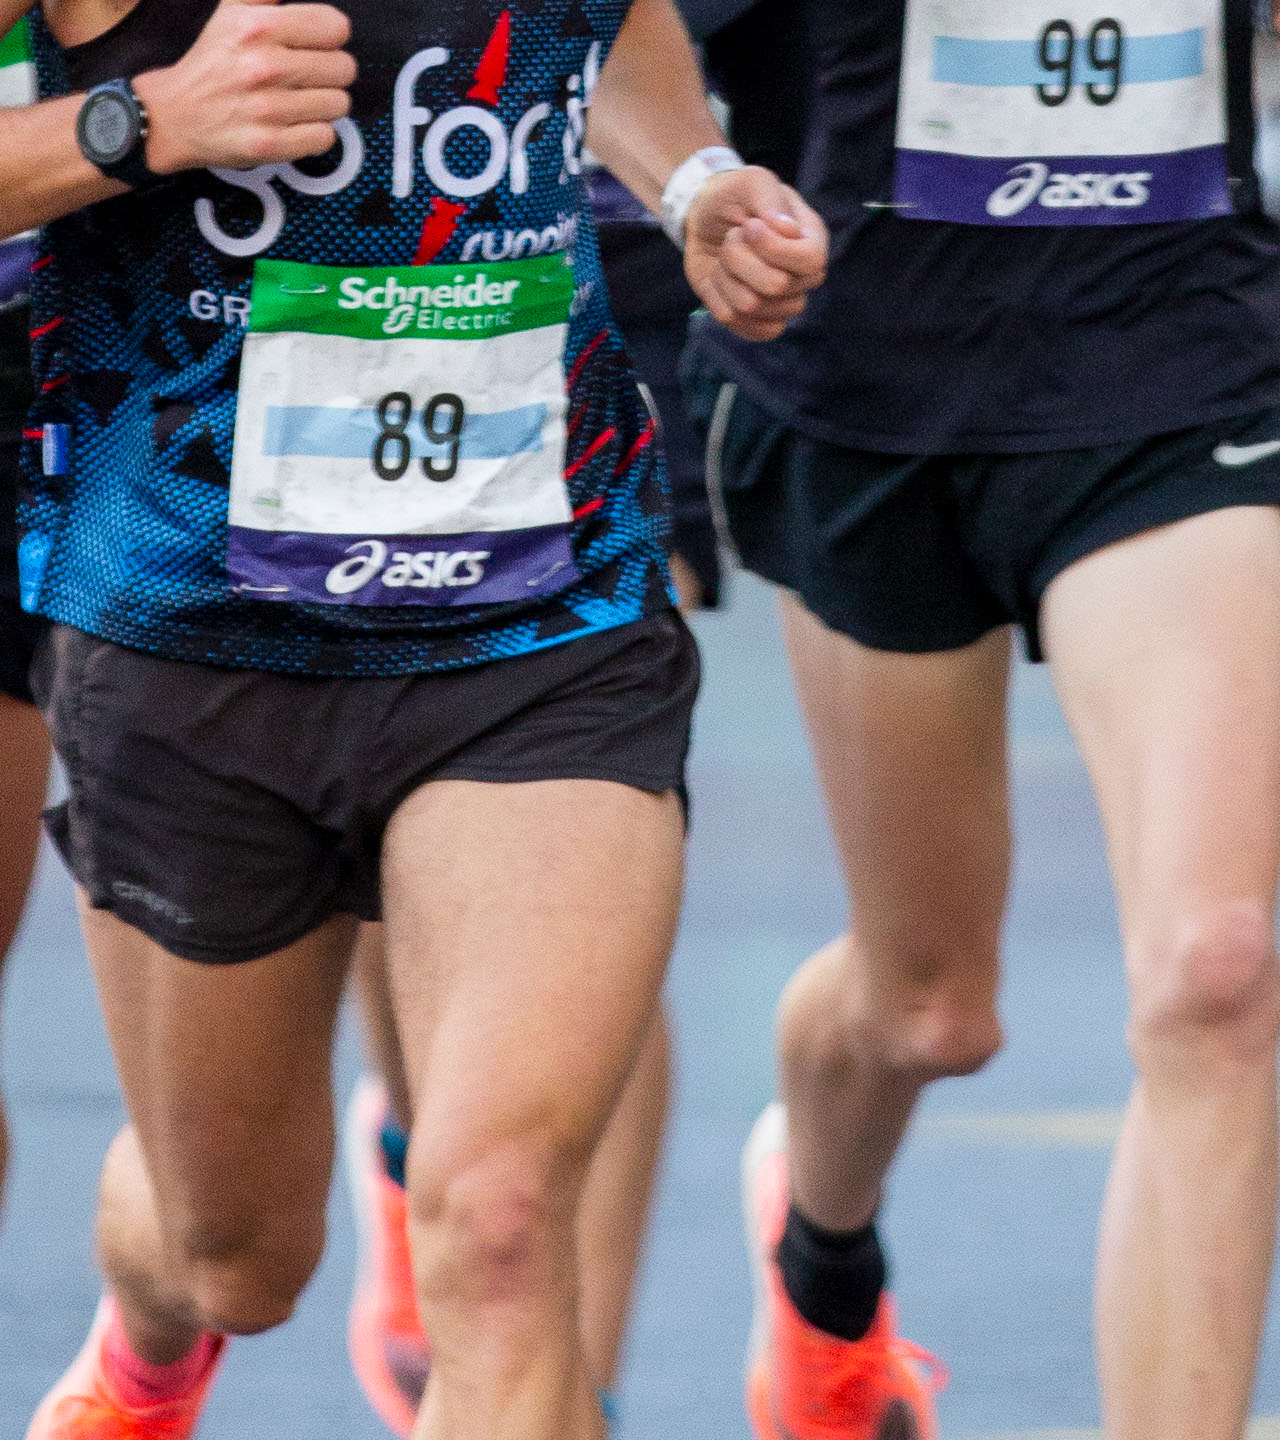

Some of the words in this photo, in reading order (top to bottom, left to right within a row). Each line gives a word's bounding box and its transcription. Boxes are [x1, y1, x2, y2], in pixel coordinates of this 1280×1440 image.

[1036, 18, 1123, 107] 99
[392, 46, 551, 199] for
[338, 274, 521, 310] Schneider
[417, 308, 515, 331] Electric
[373, 391, 465, 482] 89
